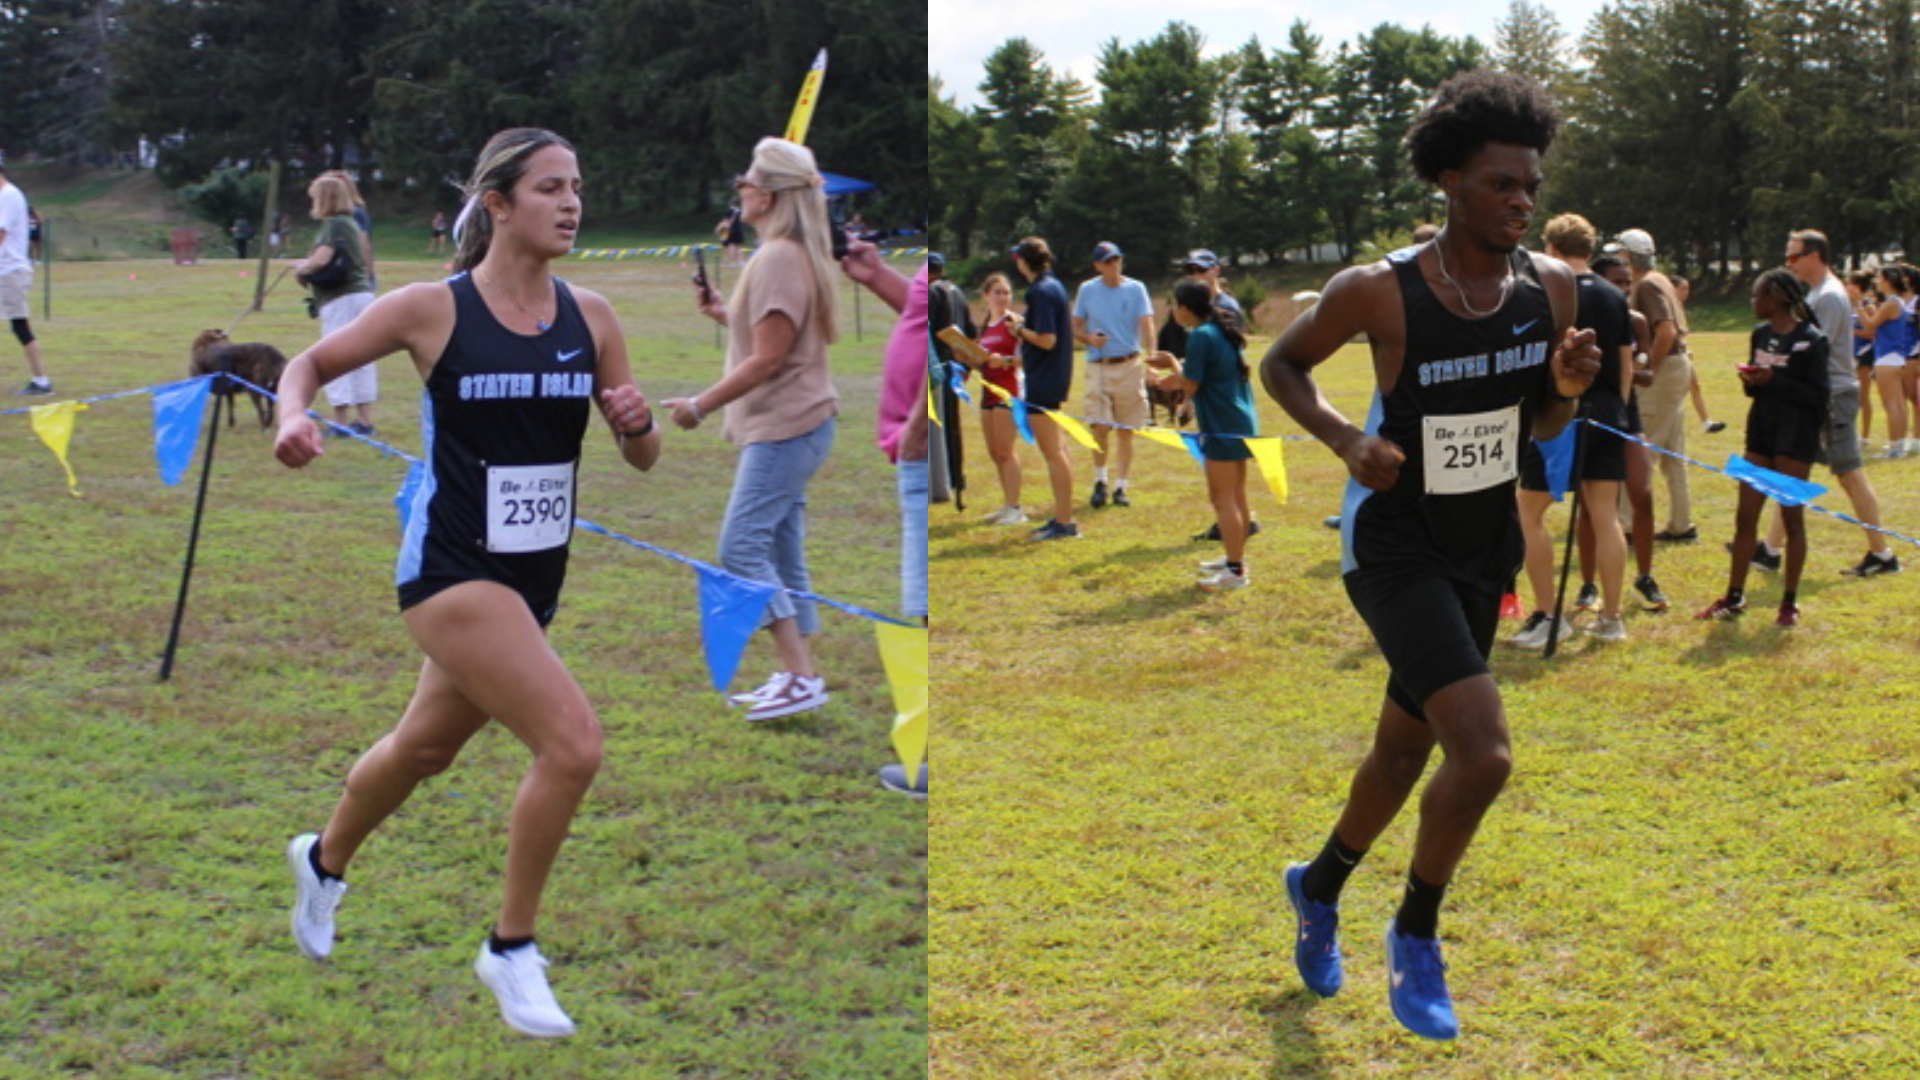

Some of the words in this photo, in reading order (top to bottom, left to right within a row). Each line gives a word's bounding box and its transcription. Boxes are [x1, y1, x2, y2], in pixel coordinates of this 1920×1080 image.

[1417, 354, 1489, 386] STATEN
[1496, 341, 1548, 374] ISLAN
[459, 373, 535, 400] STATEN
[541, 373, 592, 397] ISLAN
[1443, 438, 1504, 469] 2514
[502, 495, 567, 526] 2390
